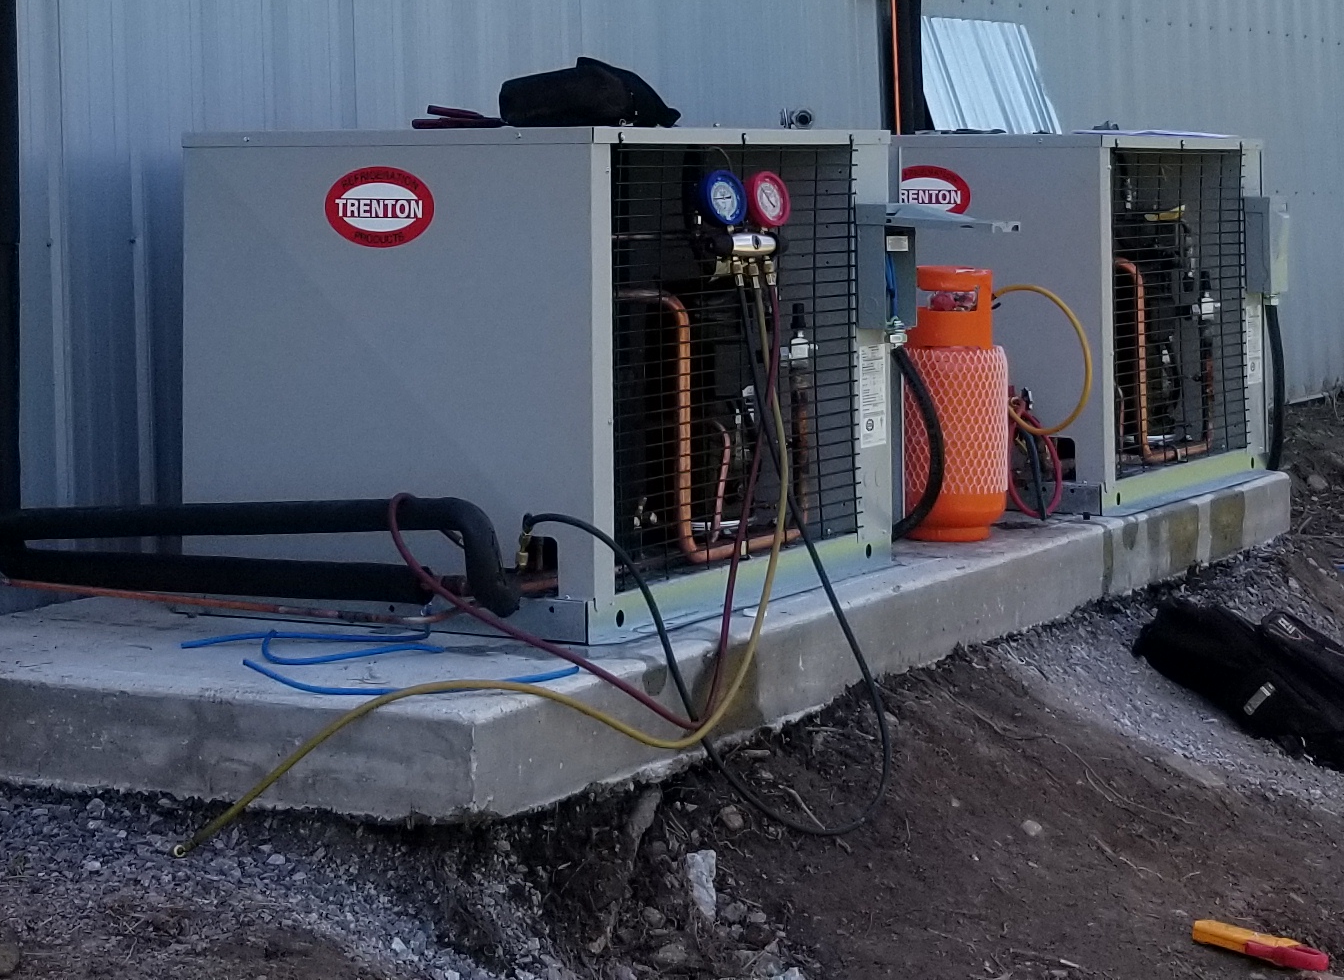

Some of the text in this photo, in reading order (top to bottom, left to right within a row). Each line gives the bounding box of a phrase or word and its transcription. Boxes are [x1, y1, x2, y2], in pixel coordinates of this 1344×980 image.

[341, 170, 419, 190] REFRIGERATION
[900, 189, 961, 205] RENTON
[335, 198, 423, 219] TRENTON
[354, 231, 405, 244] PRODUCTS
